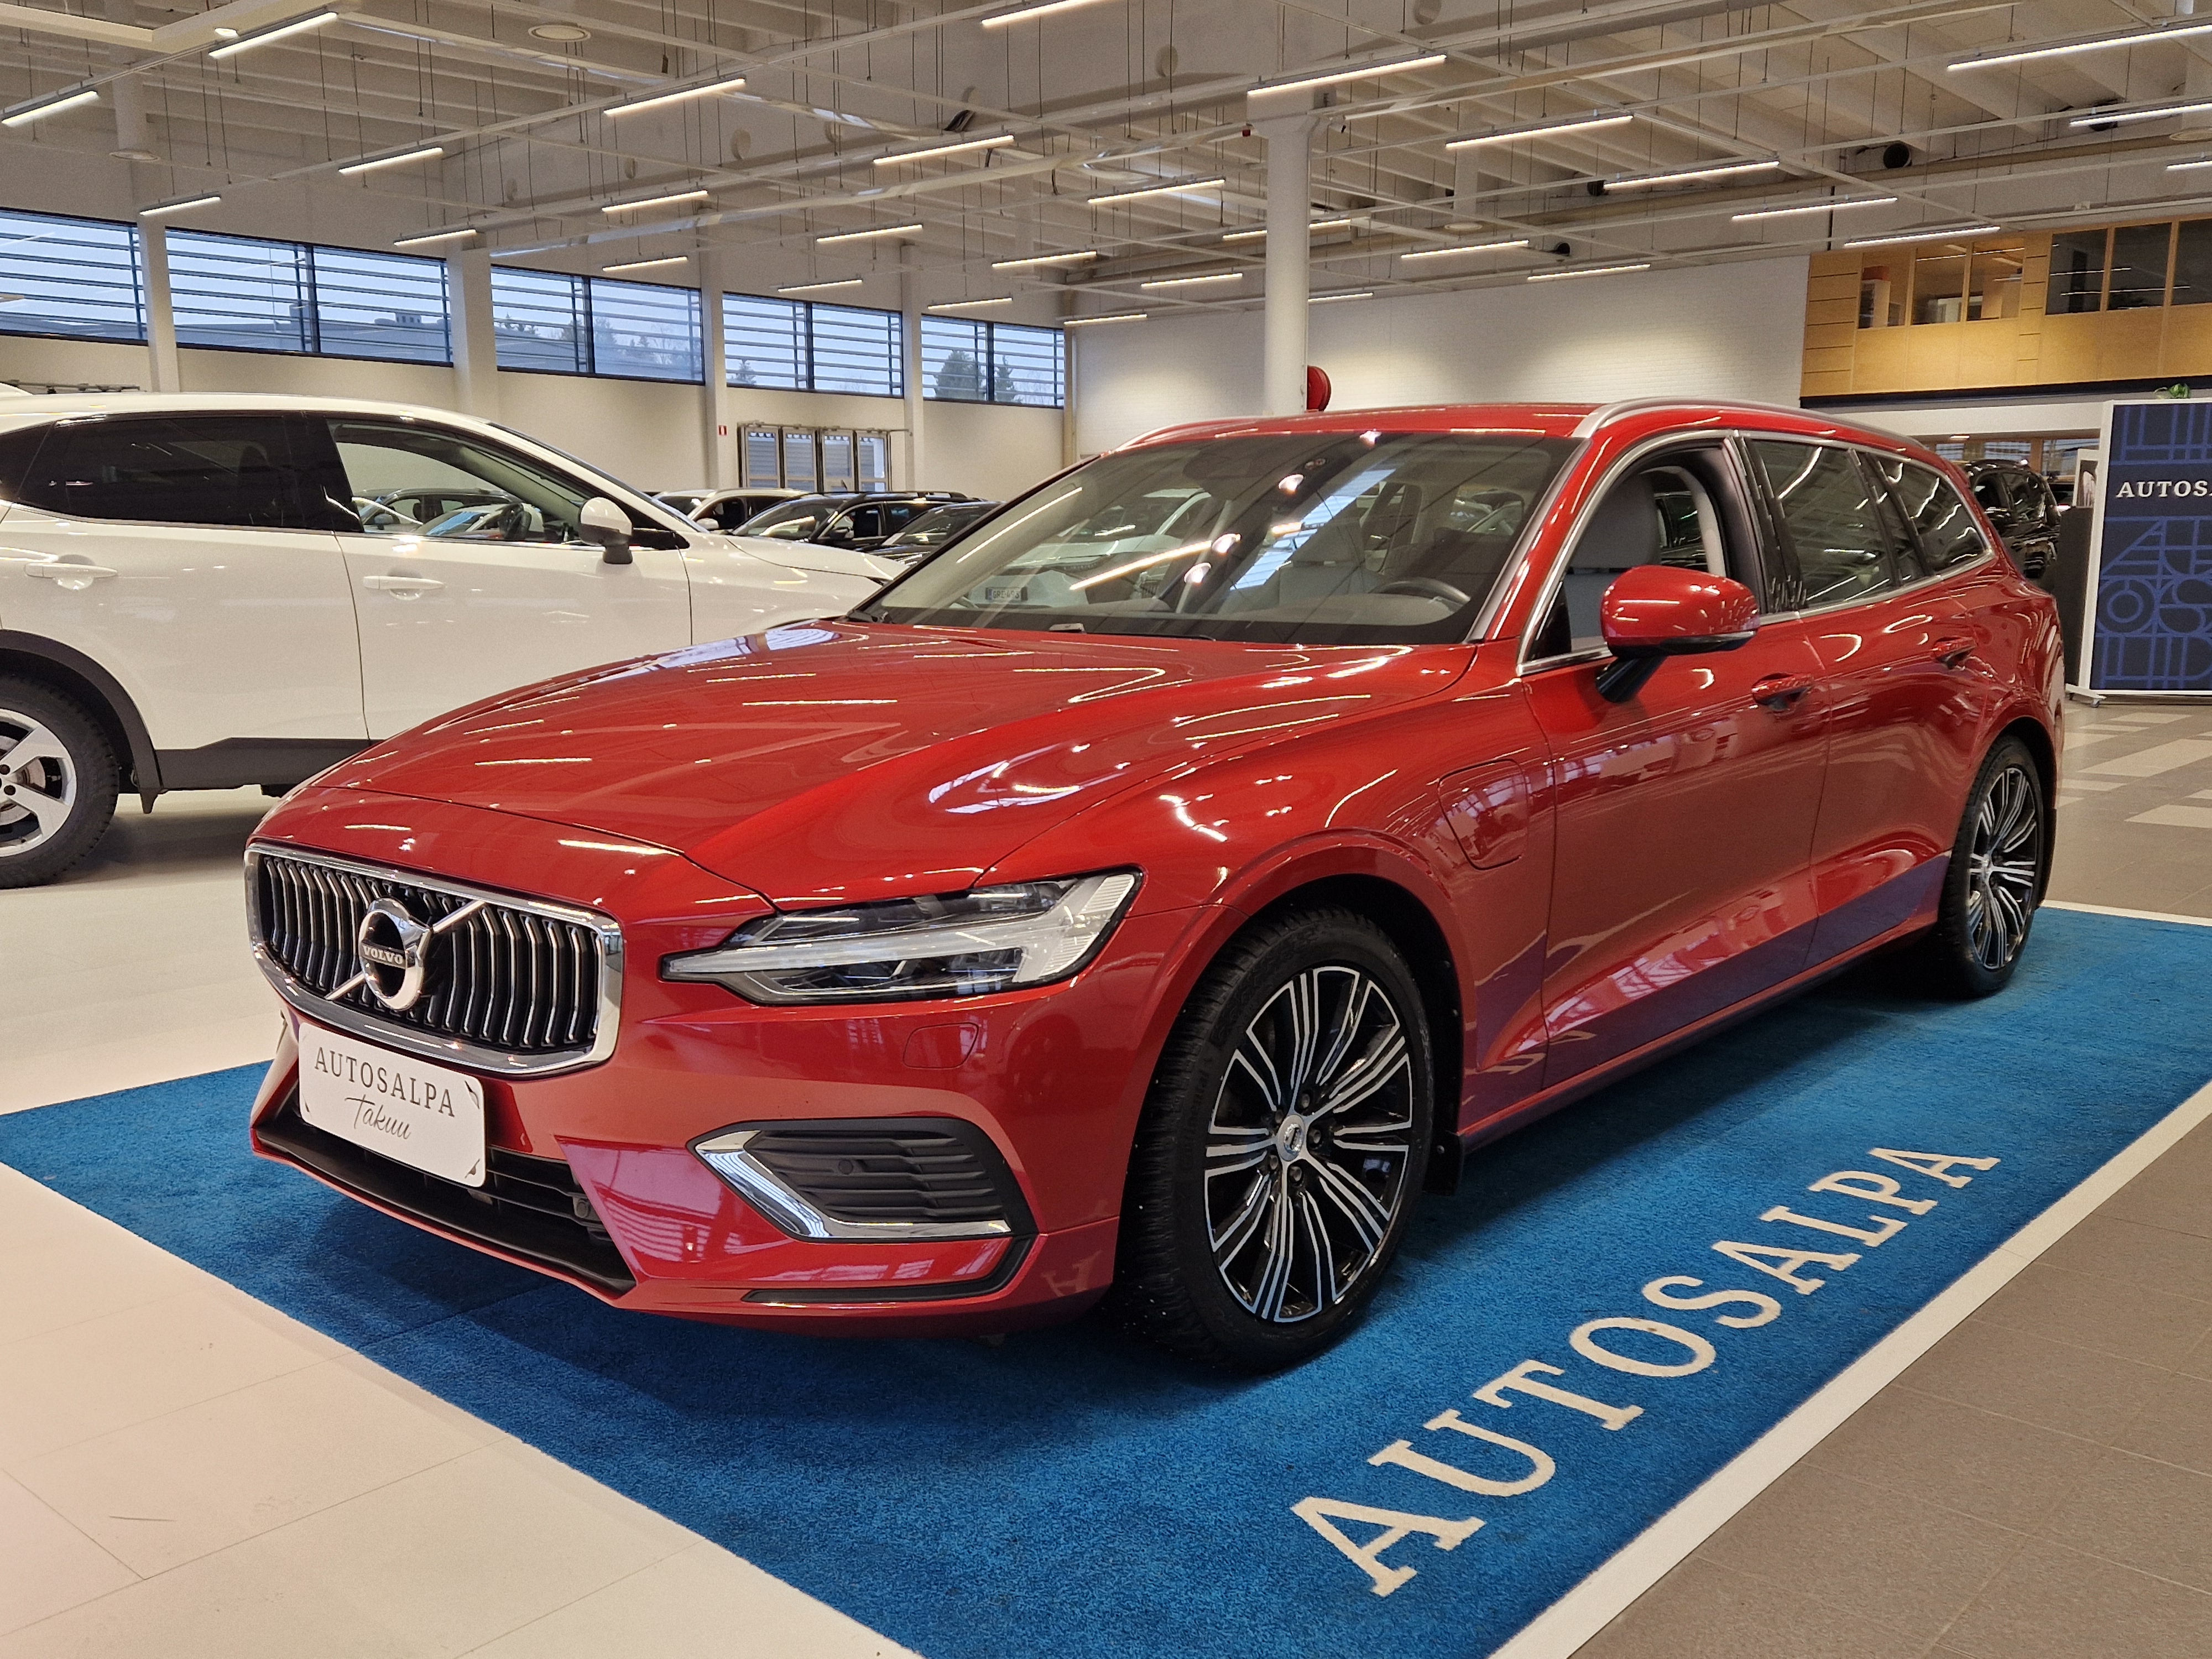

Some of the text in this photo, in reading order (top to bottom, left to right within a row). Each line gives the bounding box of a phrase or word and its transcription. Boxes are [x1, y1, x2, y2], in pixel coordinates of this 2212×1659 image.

[2116, 479, 2212, 499] AUTOS
[362, 945, 403, 964] VOLVO
[314, 1046, 455, 1118] AUTOSALPA
[344, 1094, 411, 1140] Takuu
[1290, 1147, 2001, 1598] AUTOSALPA
